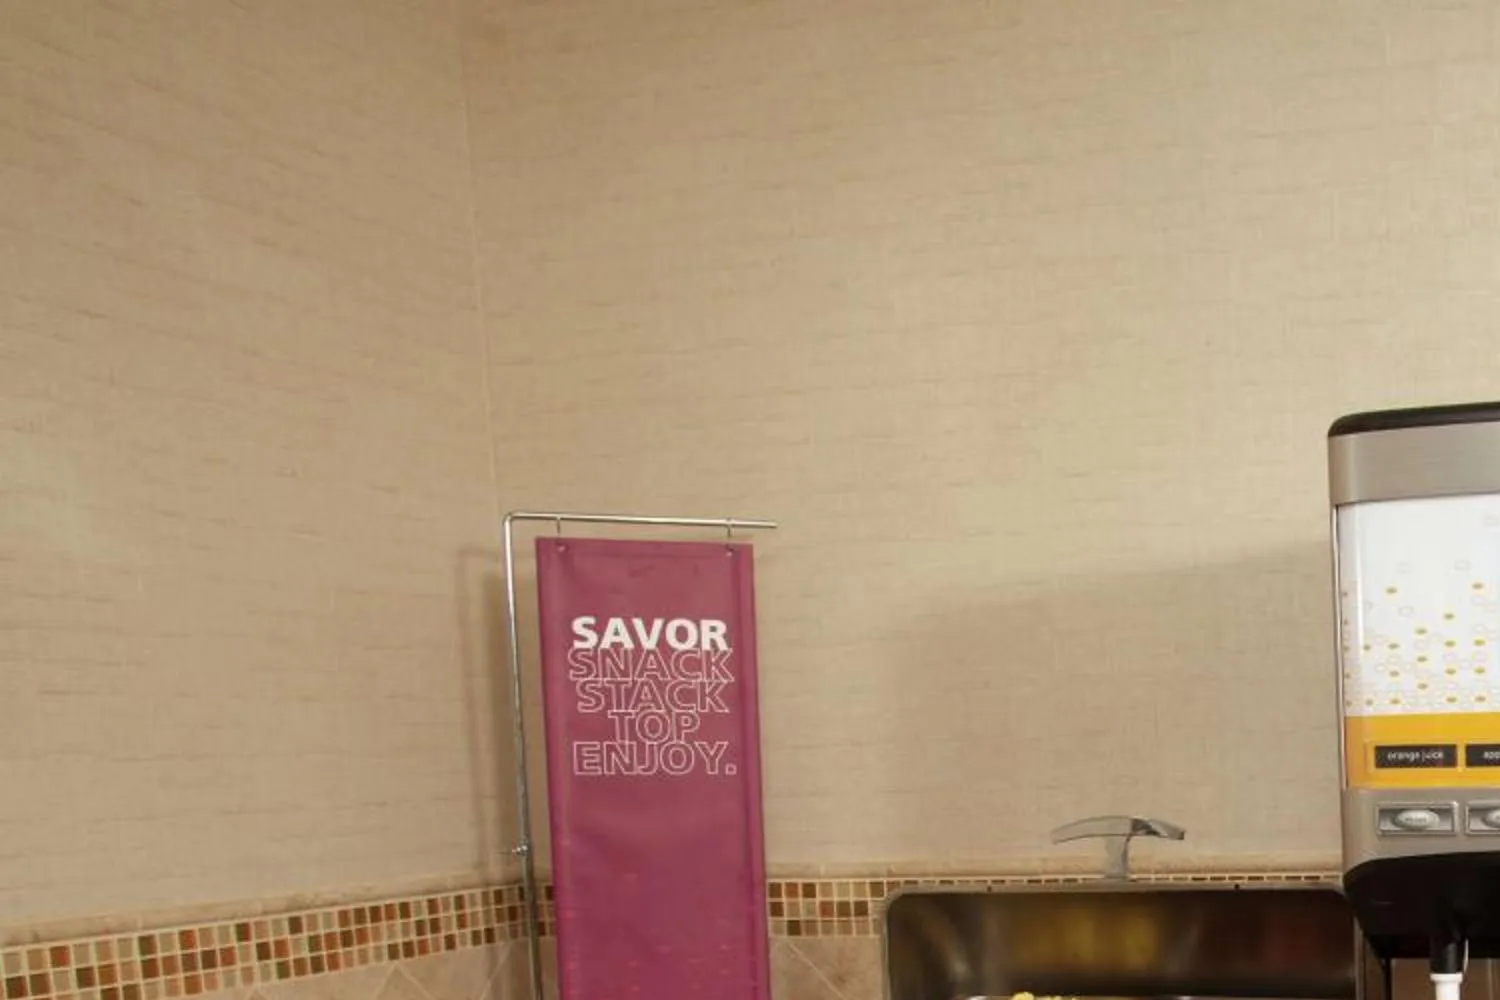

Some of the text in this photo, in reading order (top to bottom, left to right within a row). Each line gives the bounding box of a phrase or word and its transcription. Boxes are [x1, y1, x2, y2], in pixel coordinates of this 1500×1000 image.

[571, 615, 729, 651] SAVOR
[567, 648, 735, 682] SNACK
[575, 679, 730, 713] STACK
[607, 709, 701, 745] TOP
[573, 741, 737, 776] ENJOY.
[1387, 751, 1420, 762] orange
